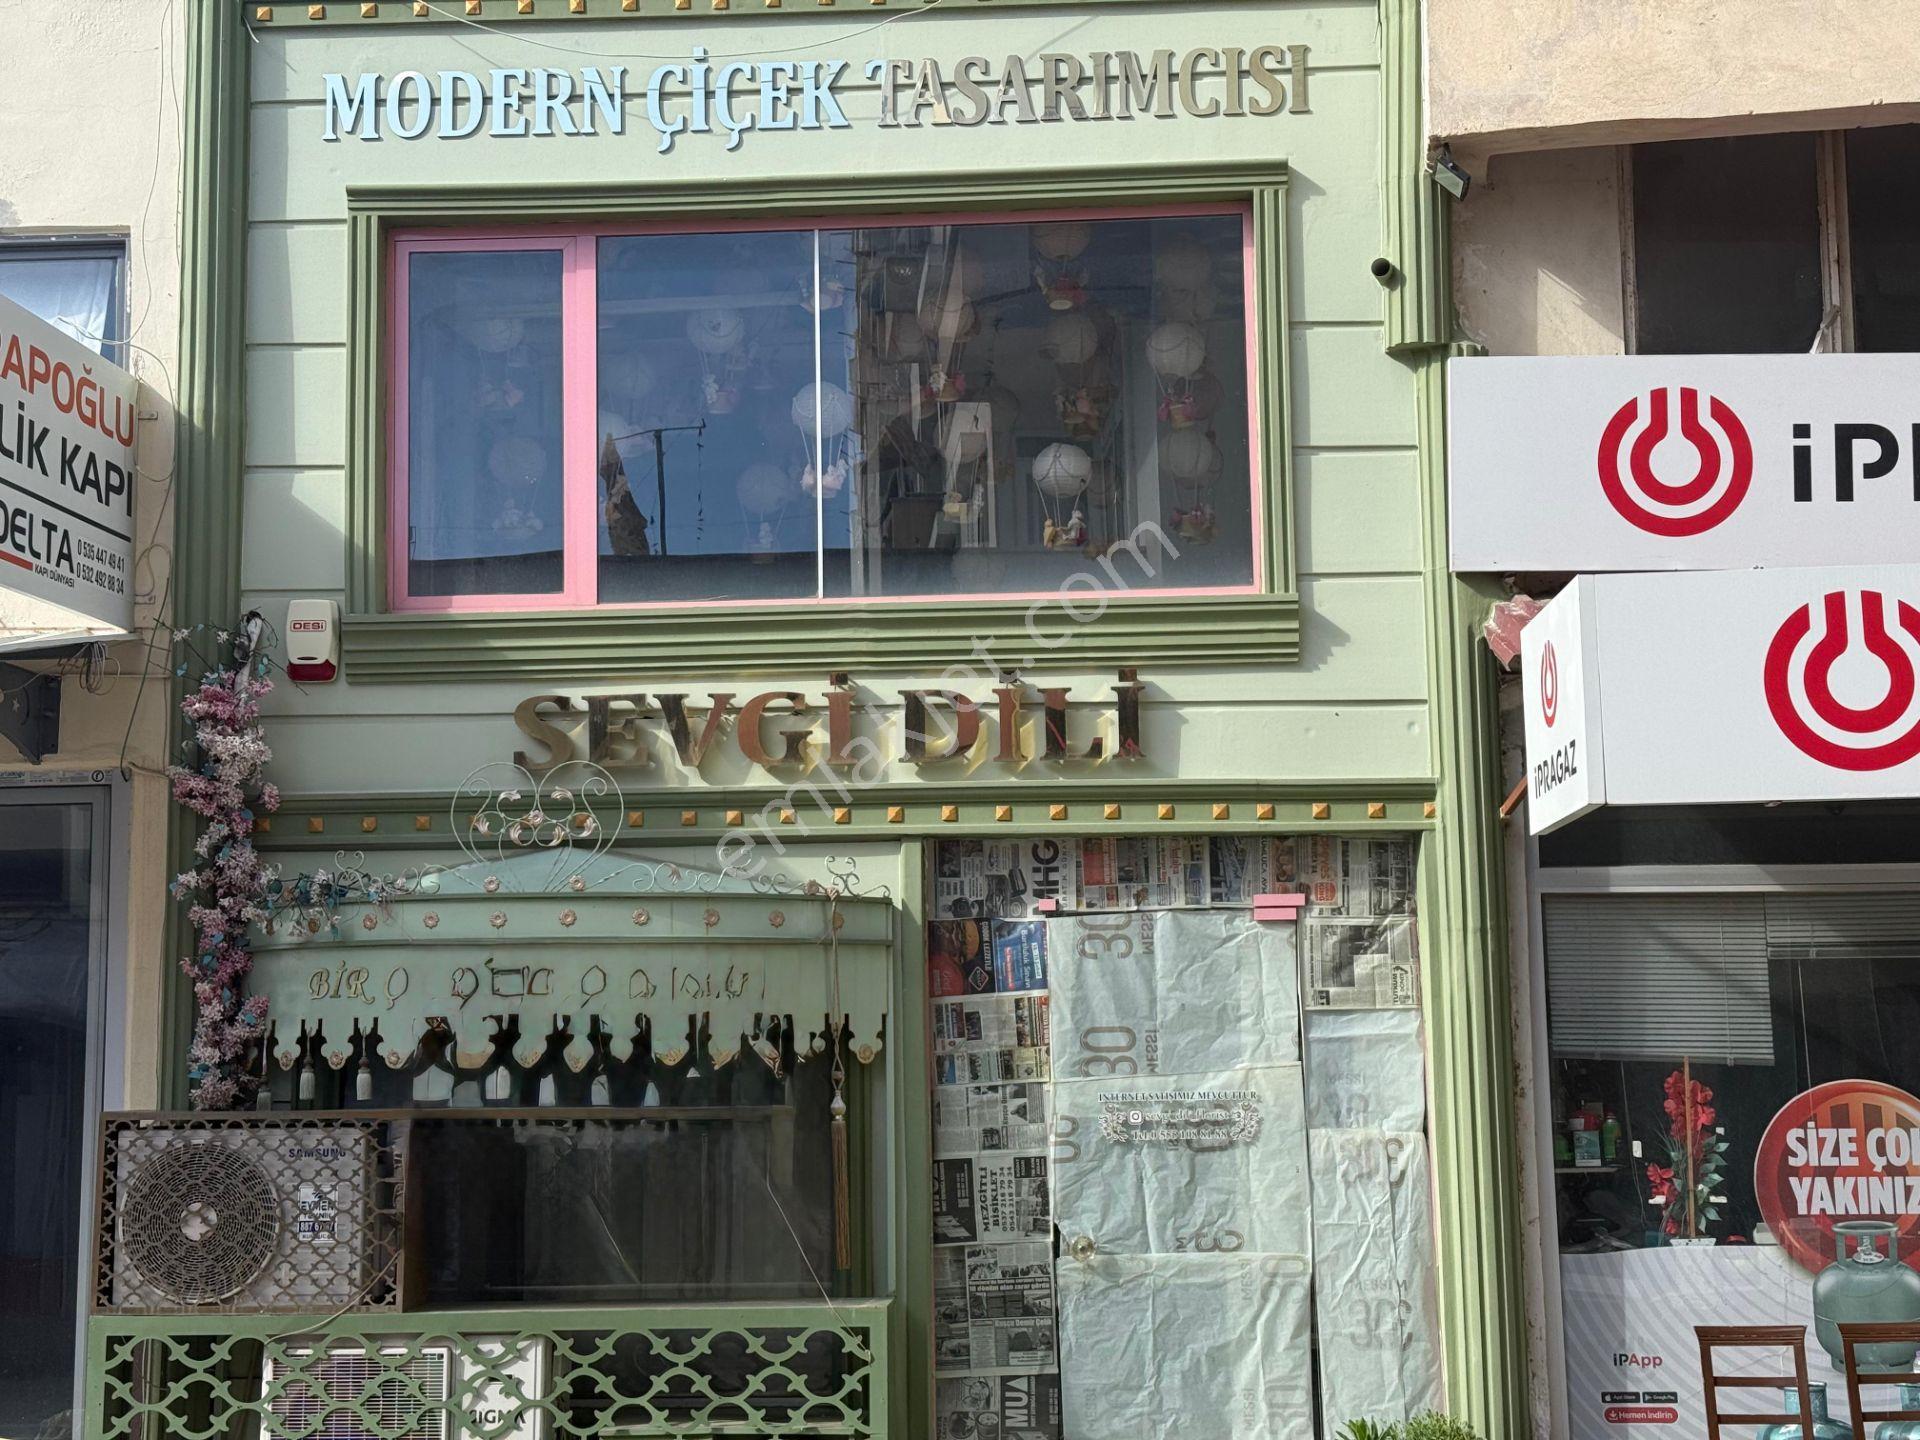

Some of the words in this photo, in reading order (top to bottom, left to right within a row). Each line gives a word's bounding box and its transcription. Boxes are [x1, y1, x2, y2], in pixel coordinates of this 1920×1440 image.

[322, 65, 627, 141] MODERN
[646, 46, 851, 154] ÇİÇEK
[865, 44, 1314, 128] TASARIMCISI
[0, 334, 134, 448] APOĞLU
[60, 435, 132, 517] KAPI
[1792, 423, 1920, 503] iP
[34, 563, 49, 578] KAPI
[49, 568, 75, 589] DÜNYASI
[77, 539, 82, 556] 0
[83, 541, 95, 561] 535
[96, 547, 108, 566] 447
[117, 556, 125, 573] 41
[77, 562, 81, 578] 0
[82, 564, 94, 584] 532
[95, 570, 107, 589] 492
[116, 577, 124, 596] 34
[512, 672, 859, 769] SEVGİ
[898, 667, 1148, 764] DİLİ
[1534, 738, 1578, 799] iPRAGAZ
[1786, 1121, 1859, 1167] SİZE
[977, 1166, 990, 1232] MEZGİTLİ
[989, 1169, 1000, 1227] BİSİKLET
[1613, 1353, 1663, 1369] iPApp
[1619, 1411, 1647, 1419] Hemen
